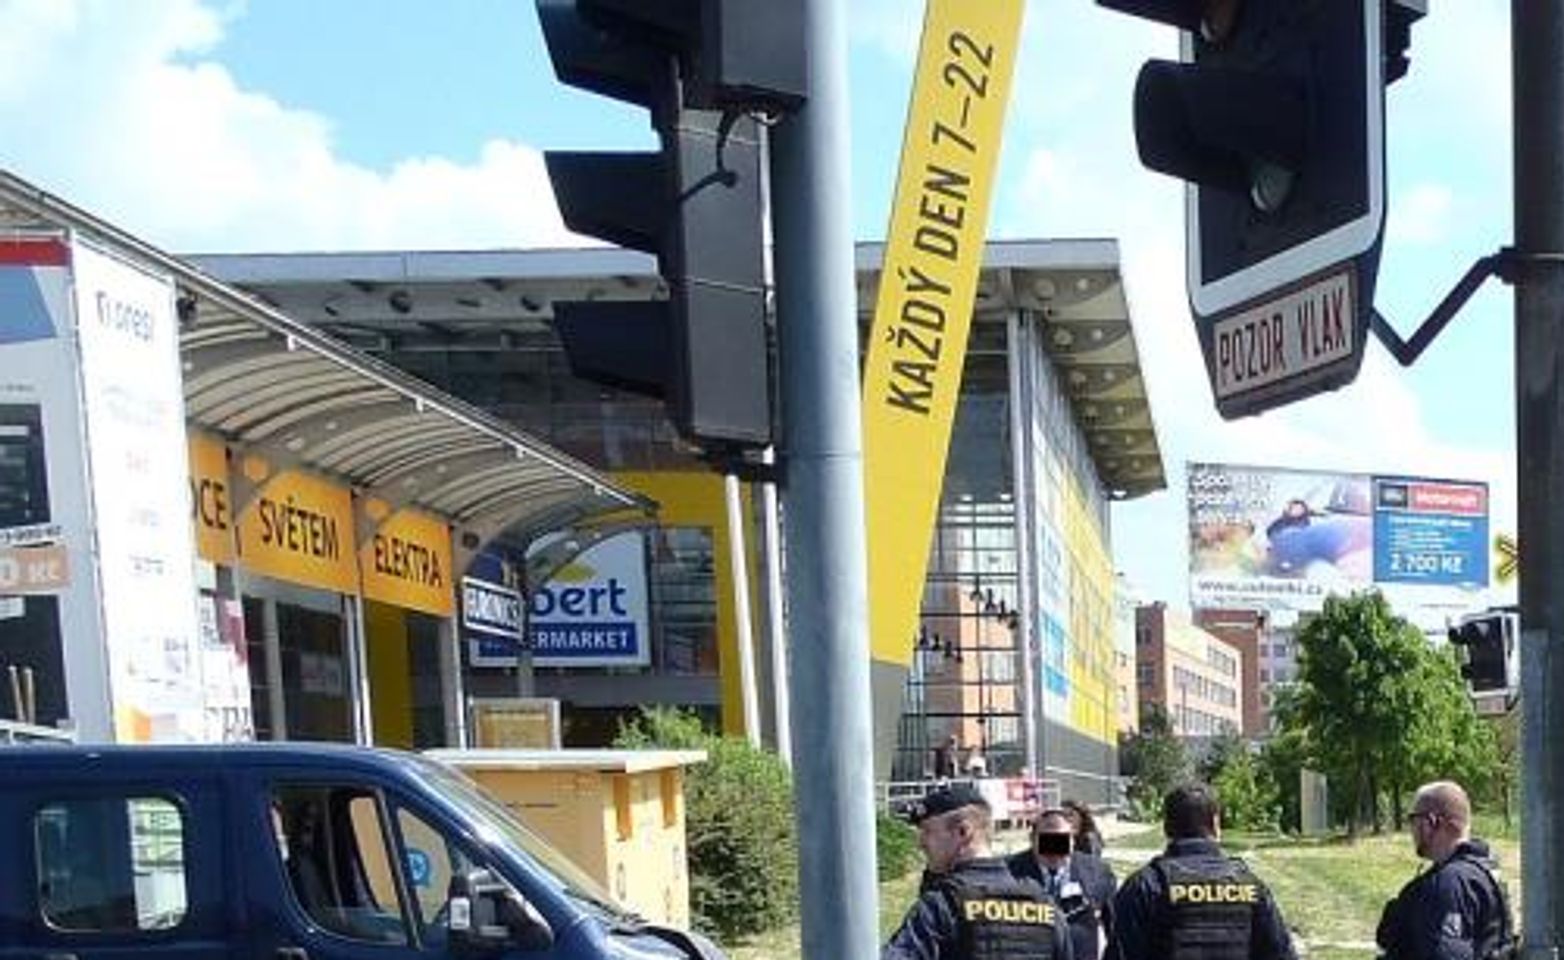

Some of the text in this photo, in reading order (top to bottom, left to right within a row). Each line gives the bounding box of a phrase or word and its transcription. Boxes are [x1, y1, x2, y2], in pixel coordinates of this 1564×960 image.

[914, 164, 971, 263] DEN
[886, 266, 953, 416] KAŽDÝ
[1219, 286, 1347, 387] POZOR VLAK
[374, 533, 443, 589] ELEKTRA
[964, 899, 1055, 925] POLICIE
[1168, 884, 1258, 903] POLICIE
